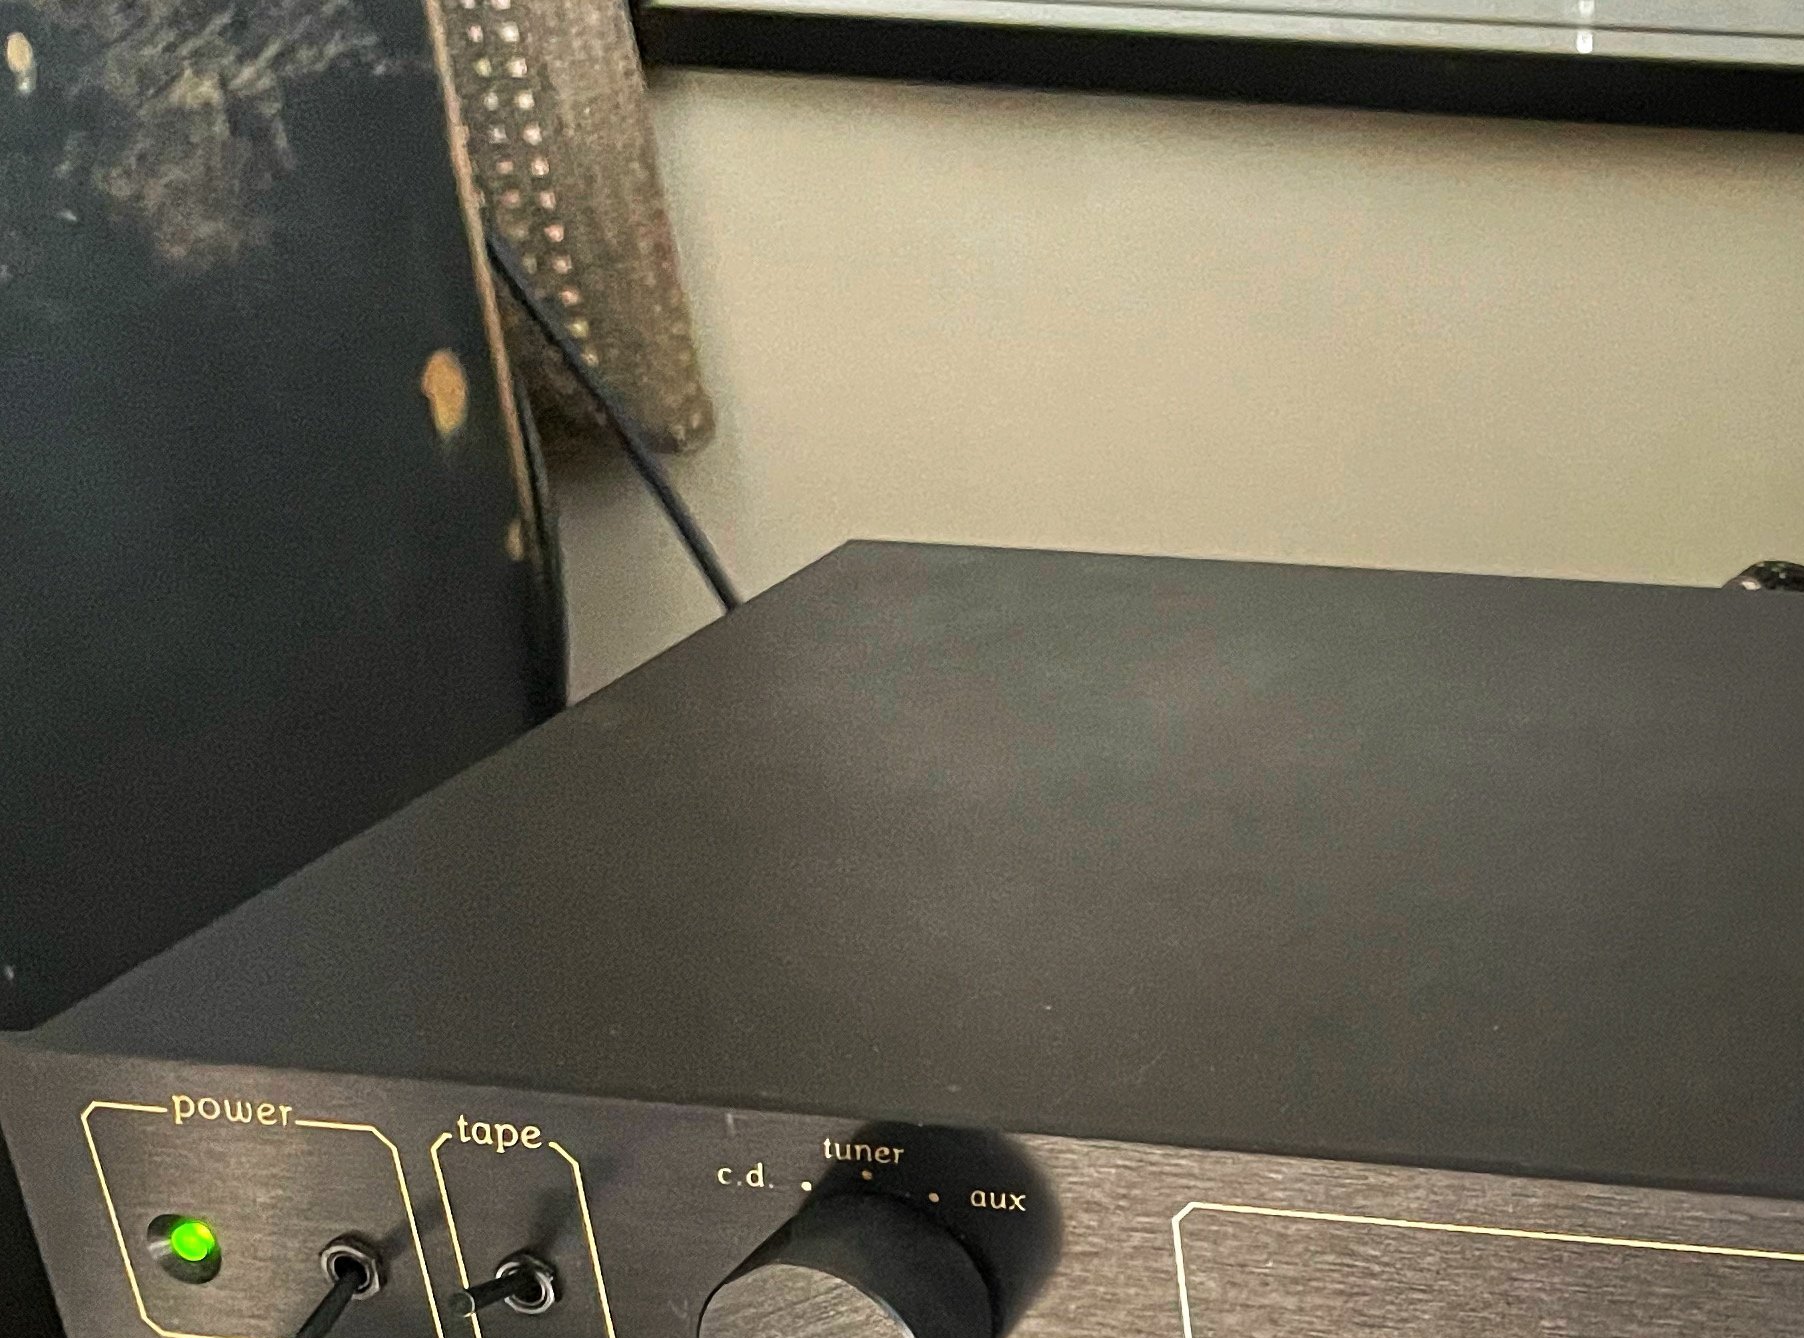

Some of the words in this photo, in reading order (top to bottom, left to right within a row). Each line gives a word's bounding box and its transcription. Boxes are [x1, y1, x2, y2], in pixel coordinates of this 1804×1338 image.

[172, 1094, 293, 1126] power
[457, 1114, 542, 1153] tape
[823, 1137, 905, 1164] tuner
[717, 1162, 775, 1188] c.d.
[970, 1189, 1027, 1212] aux
